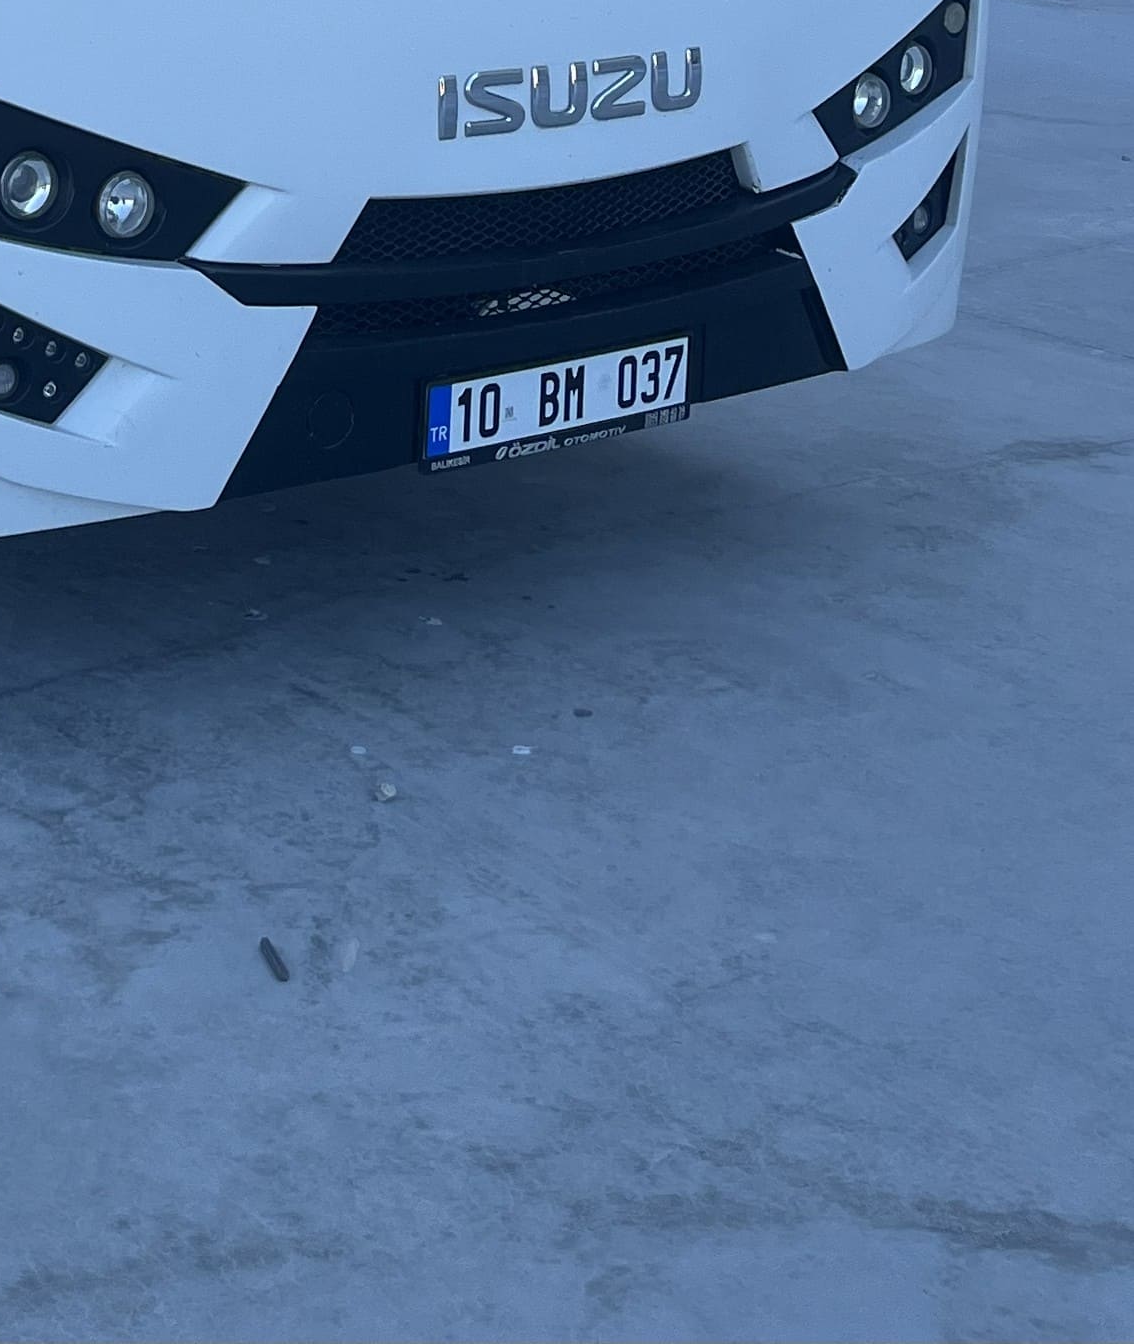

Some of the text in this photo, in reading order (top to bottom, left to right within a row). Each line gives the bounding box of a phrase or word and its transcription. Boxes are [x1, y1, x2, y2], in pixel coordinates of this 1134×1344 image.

[438, 47, 702, 141] ISUZU
[430, 425, 448, 443] TR
[458, 344, 684, 443] 10 BM 037
